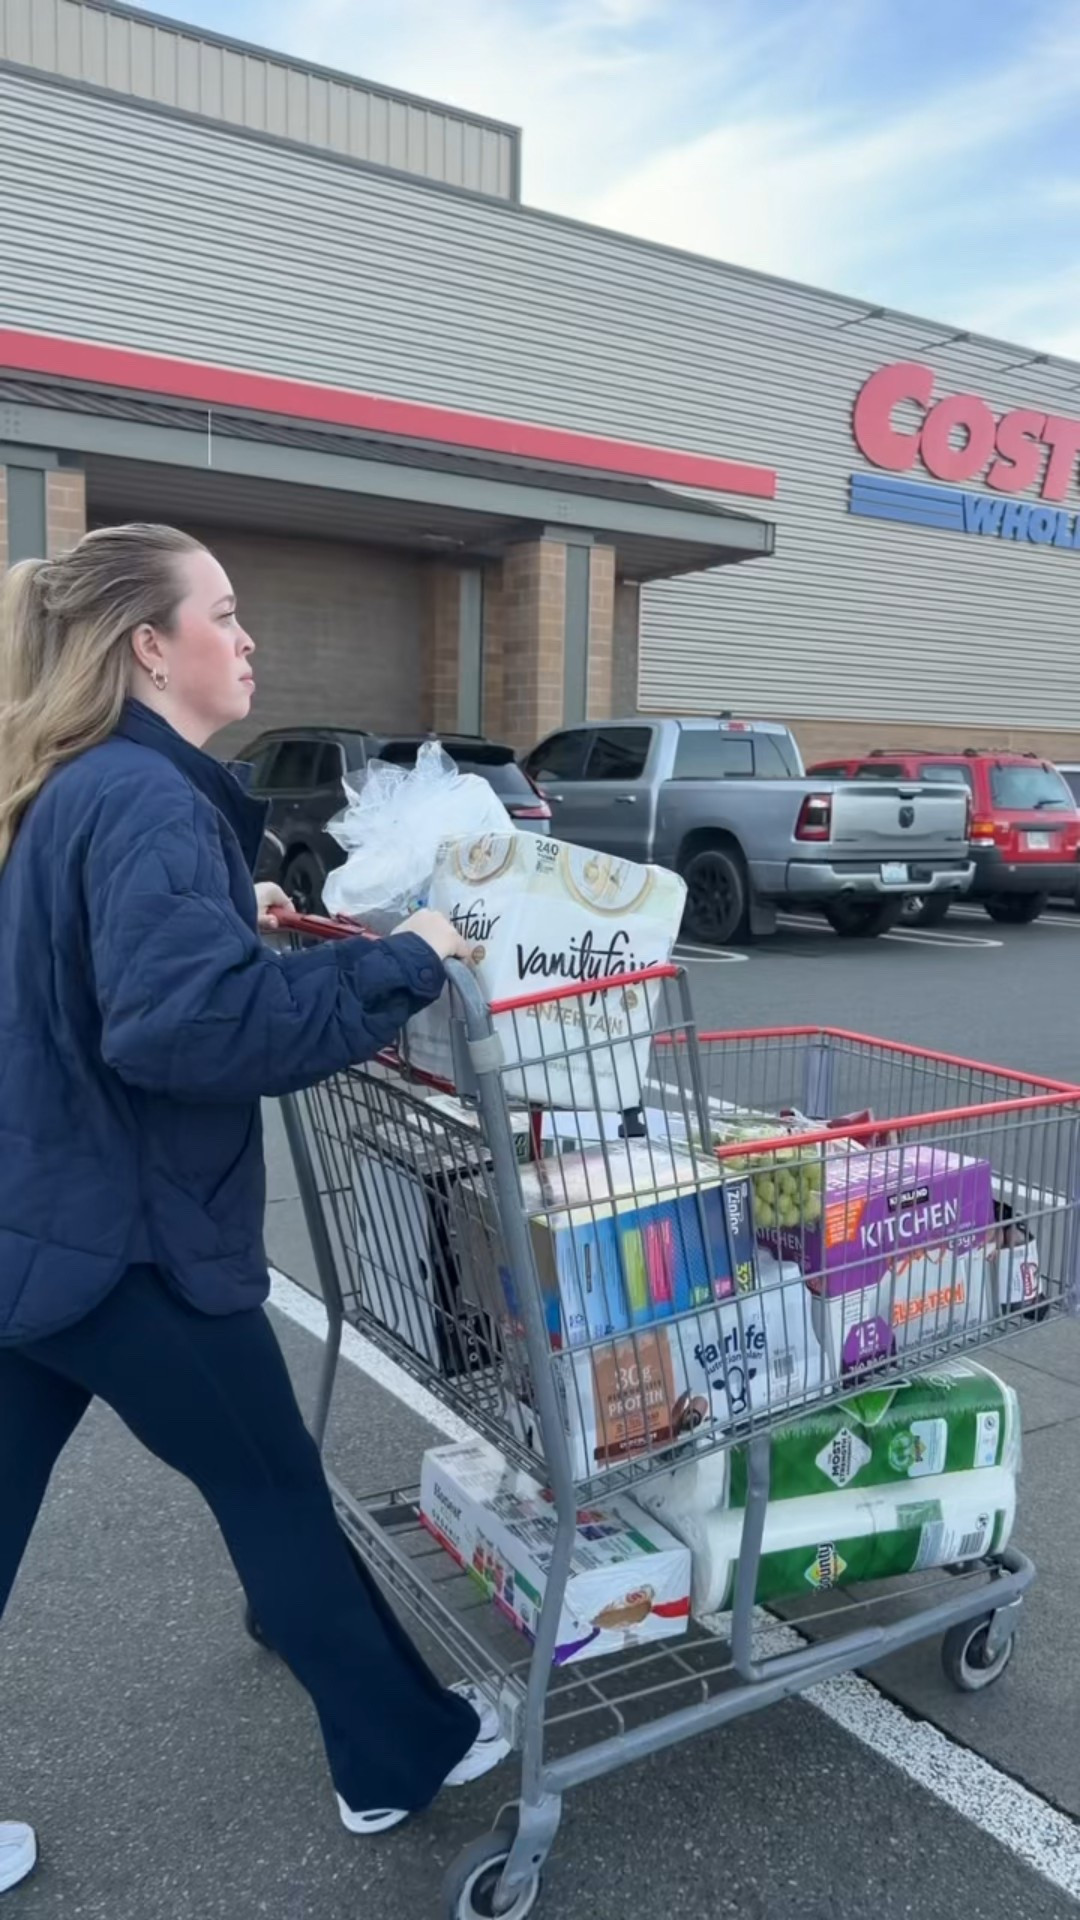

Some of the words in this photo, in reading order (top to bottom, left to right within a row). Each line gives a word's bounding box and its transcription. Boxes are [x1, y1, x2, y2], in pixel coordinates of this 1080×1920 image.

[963, 496, 1080, 549] WHOL
[535, 839, 559, 856] 240
[861, 1198, 957, 1249] KITCHEN
[694, 1324, 766, 1369] farlfe
[831, 1439, 841, 1477] MOST
